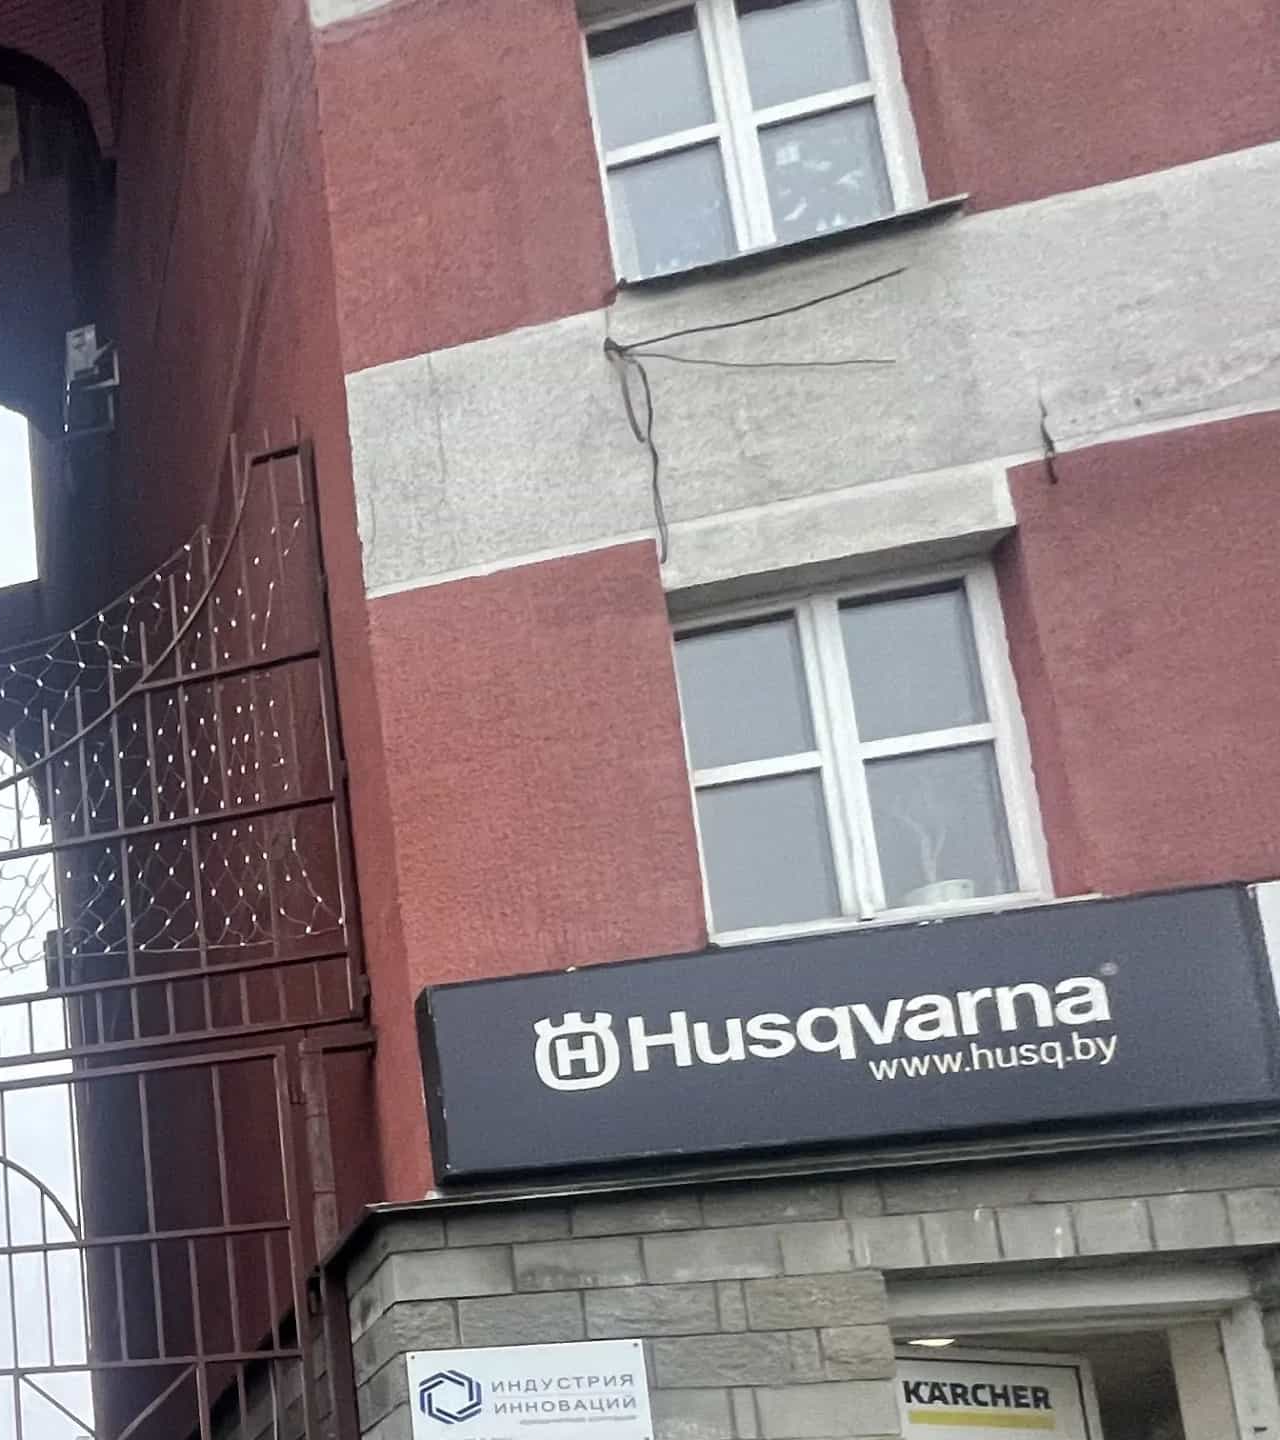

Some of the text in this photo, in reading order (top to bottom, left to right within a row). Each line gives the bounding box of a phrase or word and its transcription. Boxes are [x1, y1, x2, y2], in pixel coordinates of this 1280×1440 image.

[627, 975, 1112, 1072] Husqvarna
[868, 1031, 1118, 1081] www.husq.by
[491, 1373, 635, 1394] ИНДУСТРИЯ
[901, 1379, 1053, 1410] KÄRCHER
[494, 1396, 638, 1415] ИННОВАЦИЙ
